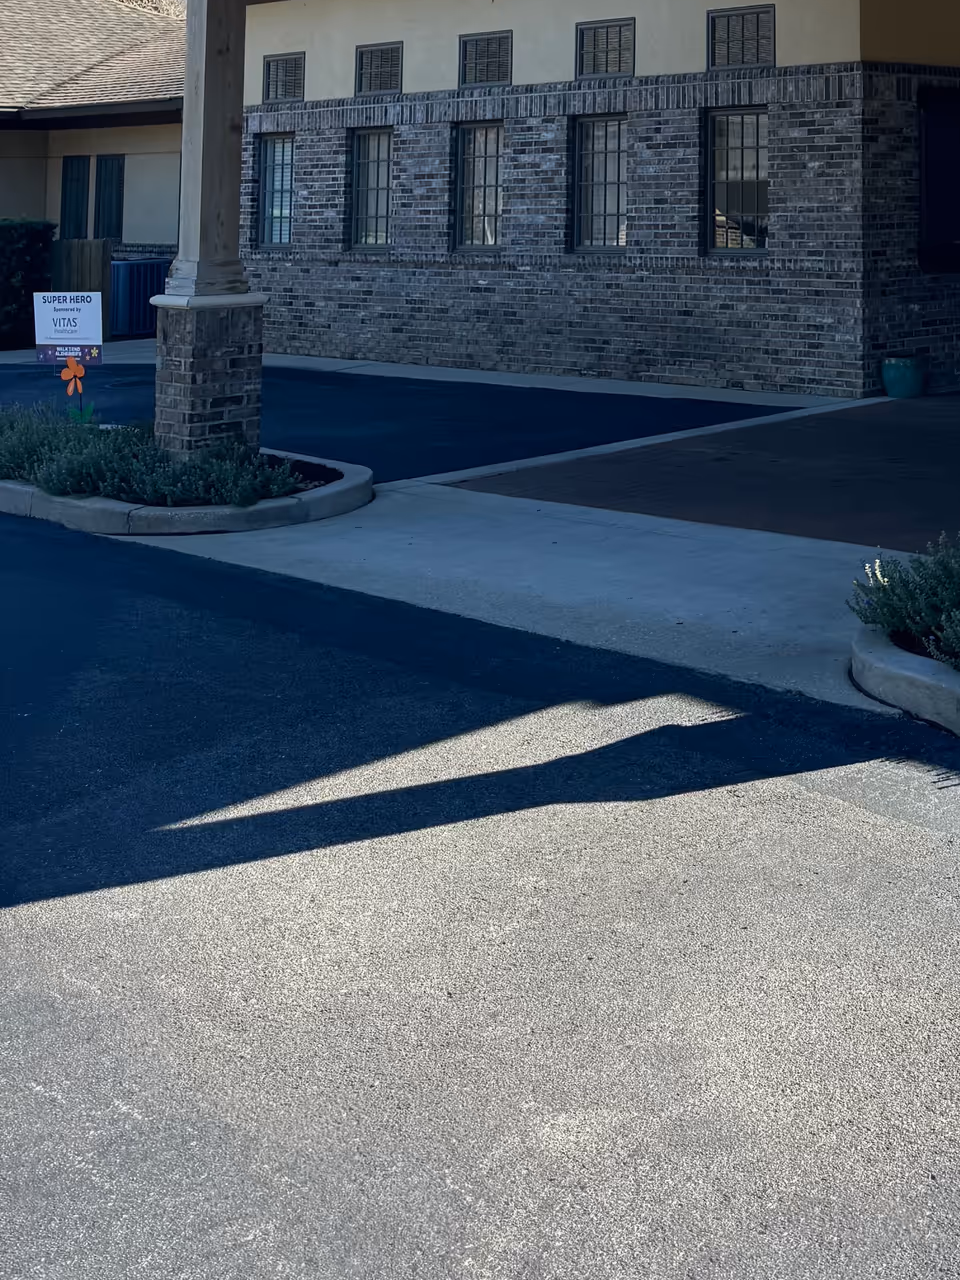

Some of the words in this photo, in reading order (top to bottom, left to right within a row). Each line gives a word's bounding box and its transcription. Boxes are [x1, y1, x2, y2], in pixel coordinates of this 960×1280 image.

[42, 295, 67, 304] SUPER
[69, 295, 92, 304] HERO
[52, 317, 77, 327] VITAS
